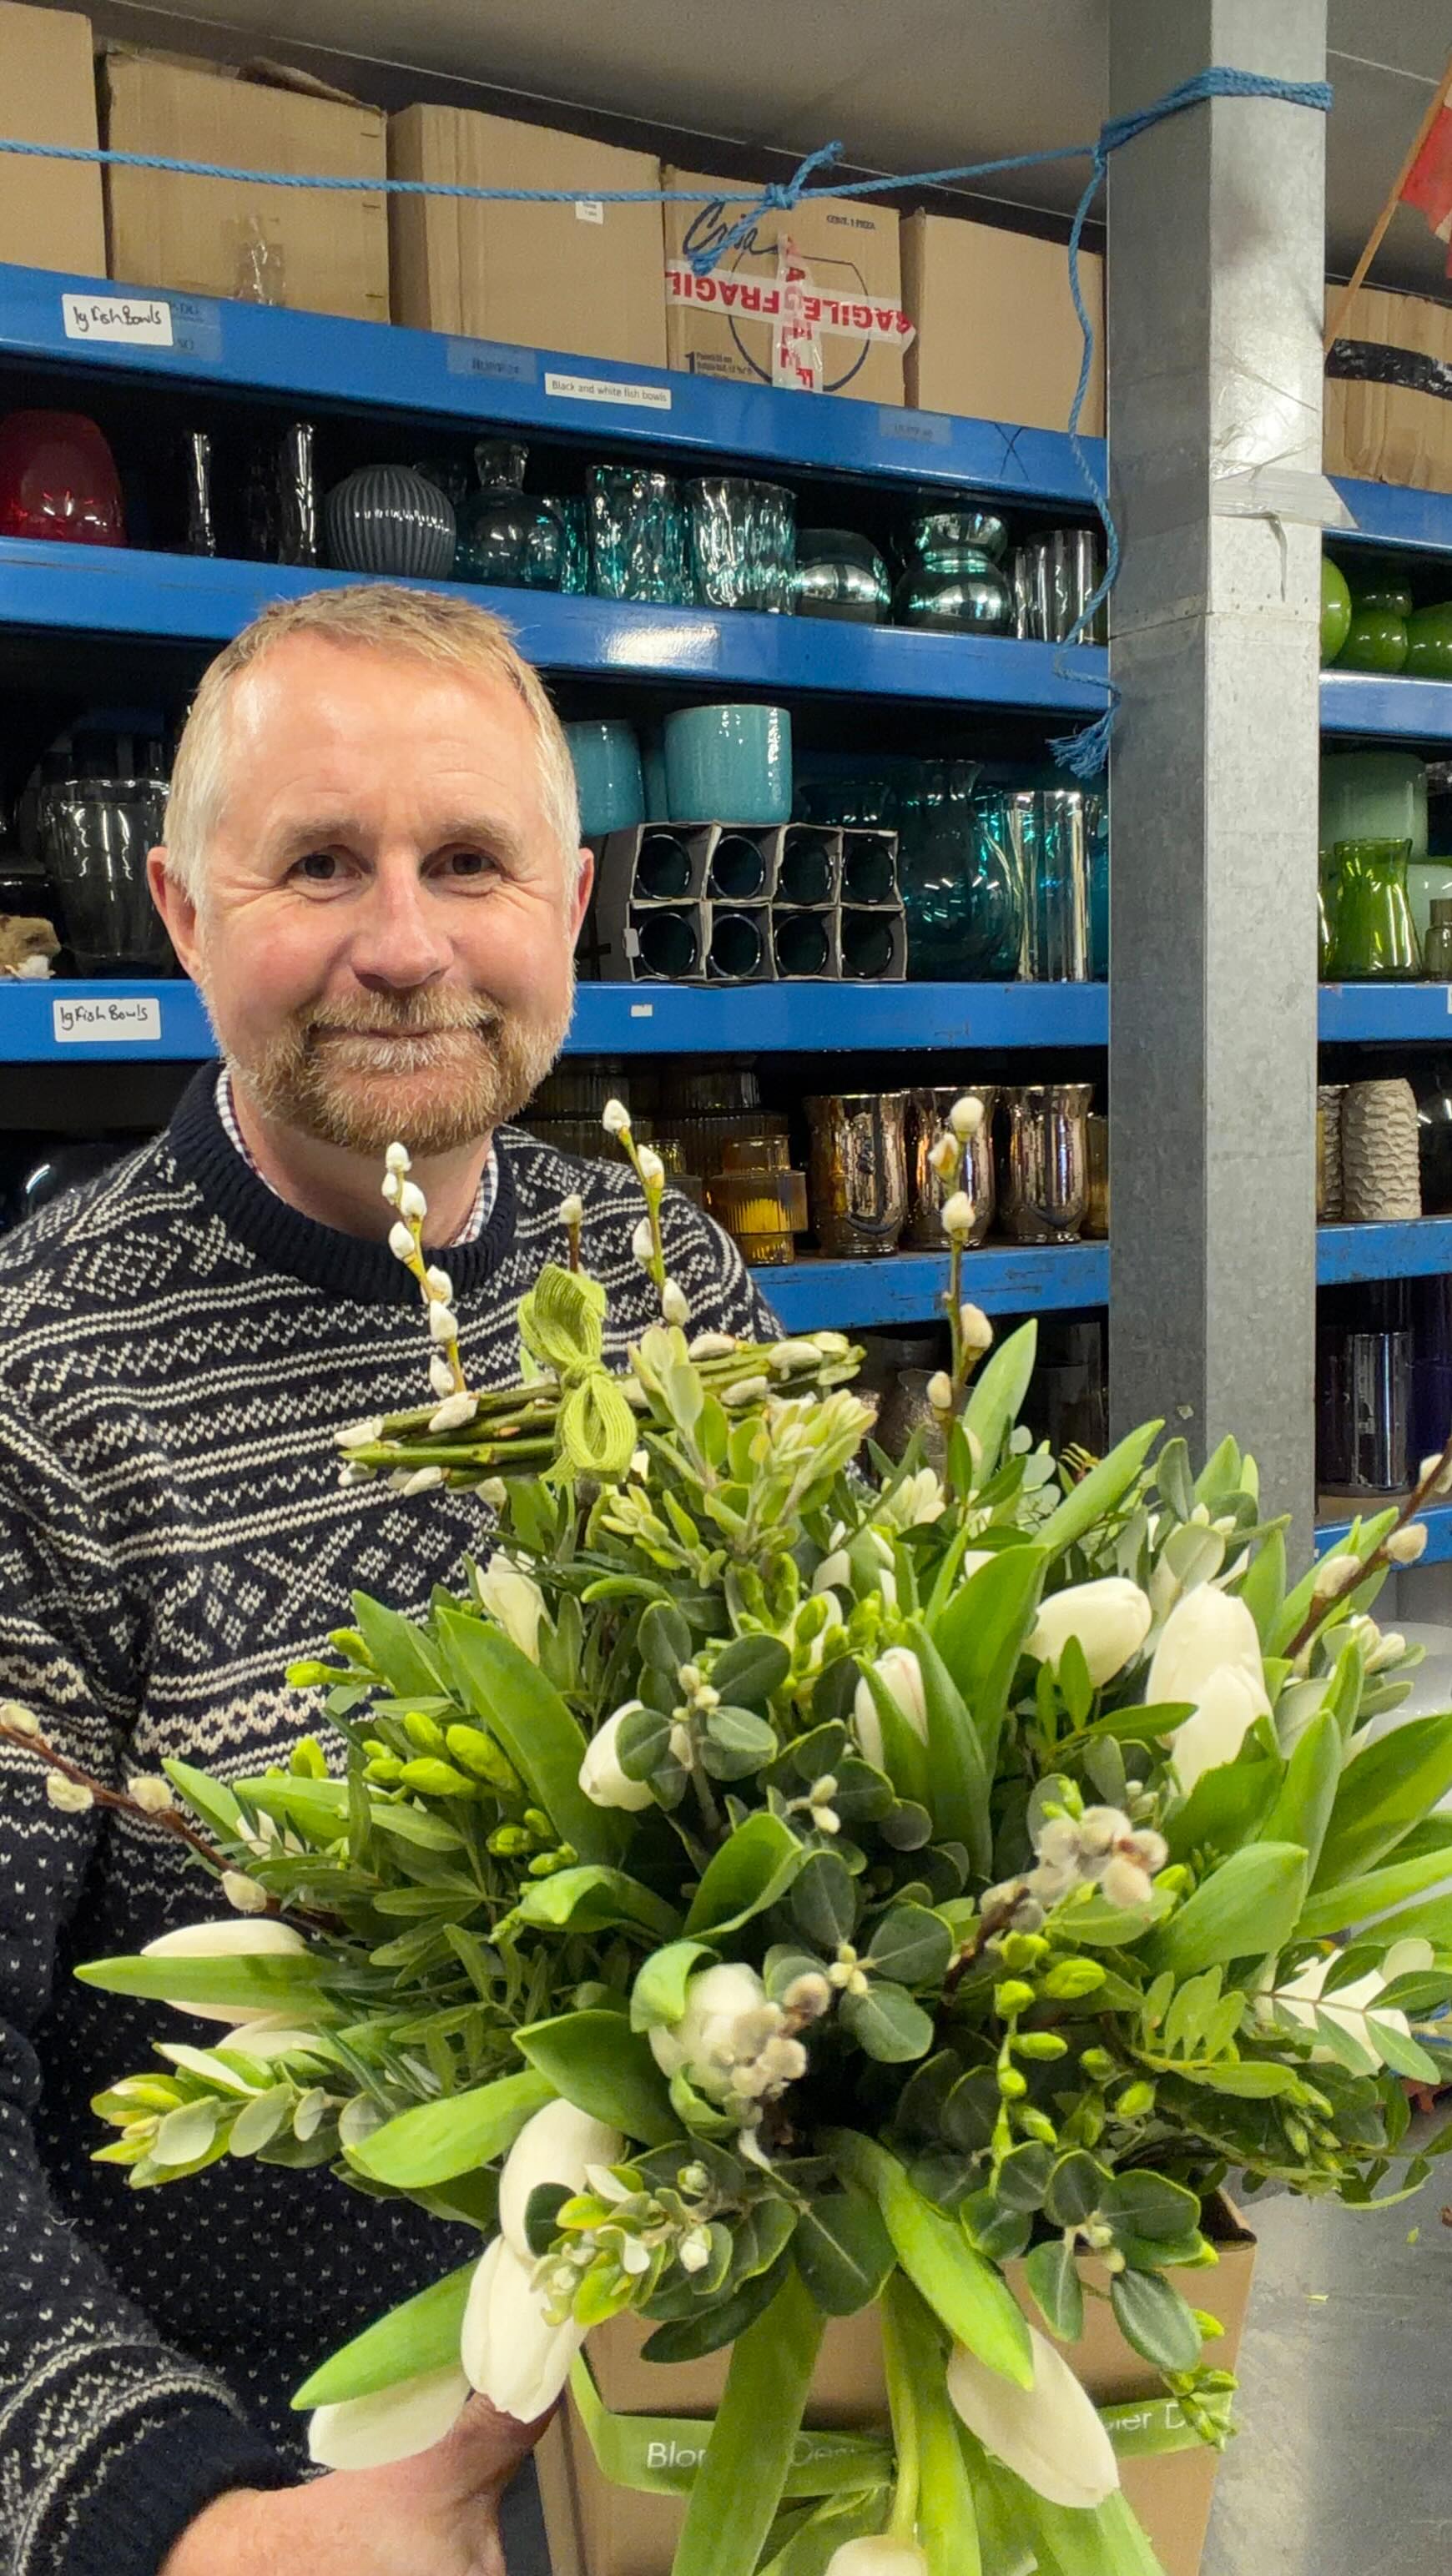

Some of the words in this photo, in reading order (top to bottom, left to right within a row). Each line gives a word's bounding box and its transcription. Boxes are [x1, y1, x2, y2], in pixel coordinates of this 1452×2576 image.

[552, 380, 575, 391] Black
[578, 384, 595, 394] and
[597, 385, 622, 397] white
[623, 387, 640, 399] fish
[642, 390, 667, 402] bowls
